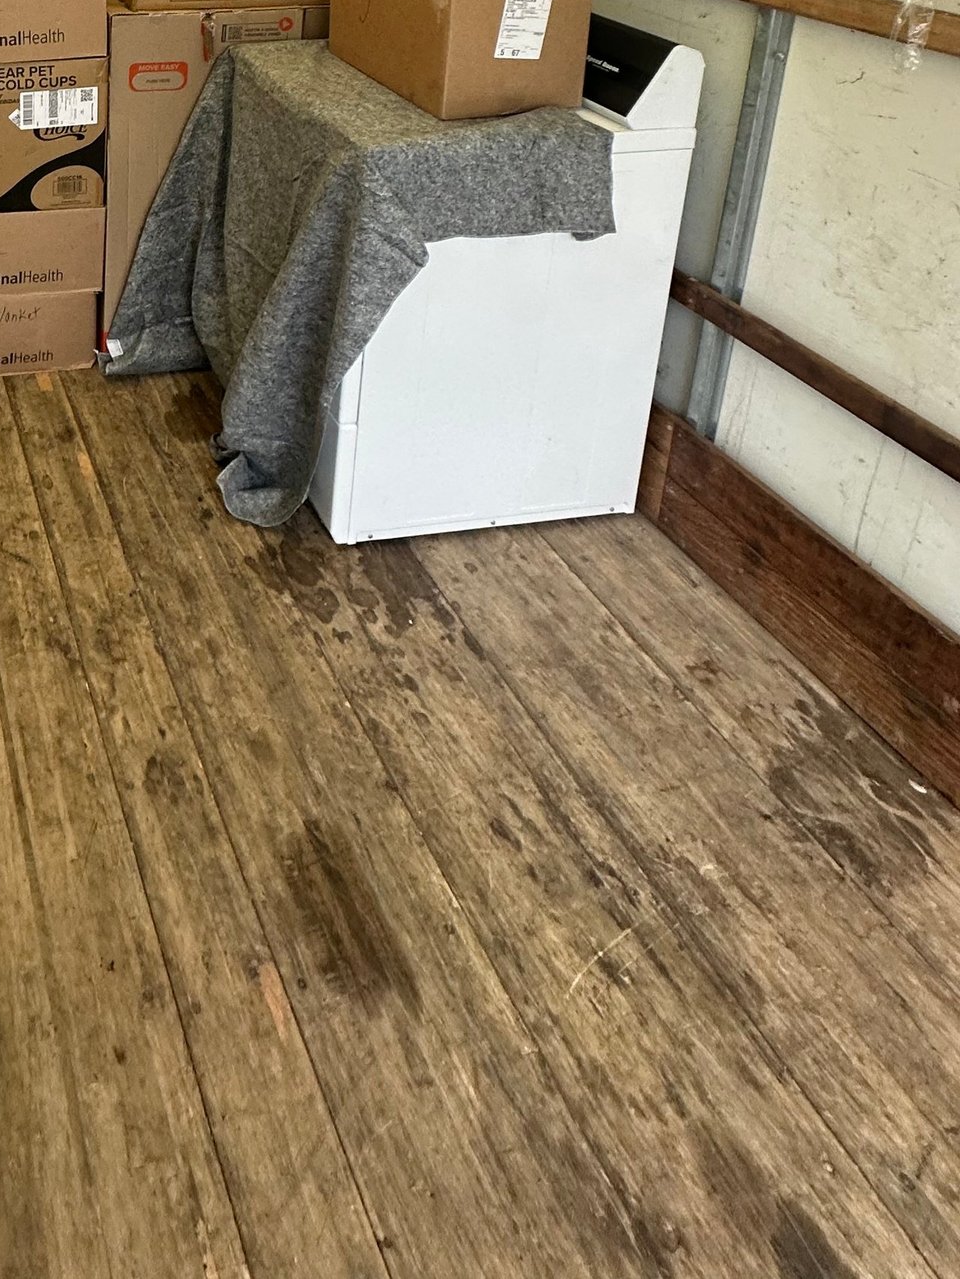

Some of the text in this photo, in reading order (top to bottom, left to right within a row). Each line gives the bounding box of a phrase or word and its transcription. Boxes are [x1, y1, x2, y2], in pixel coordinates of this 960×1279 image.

[29, 65, 55, 77] PET
[138, 61, 181, 71] MOVE EASY
[39, 75, 77, 89] CUPS
